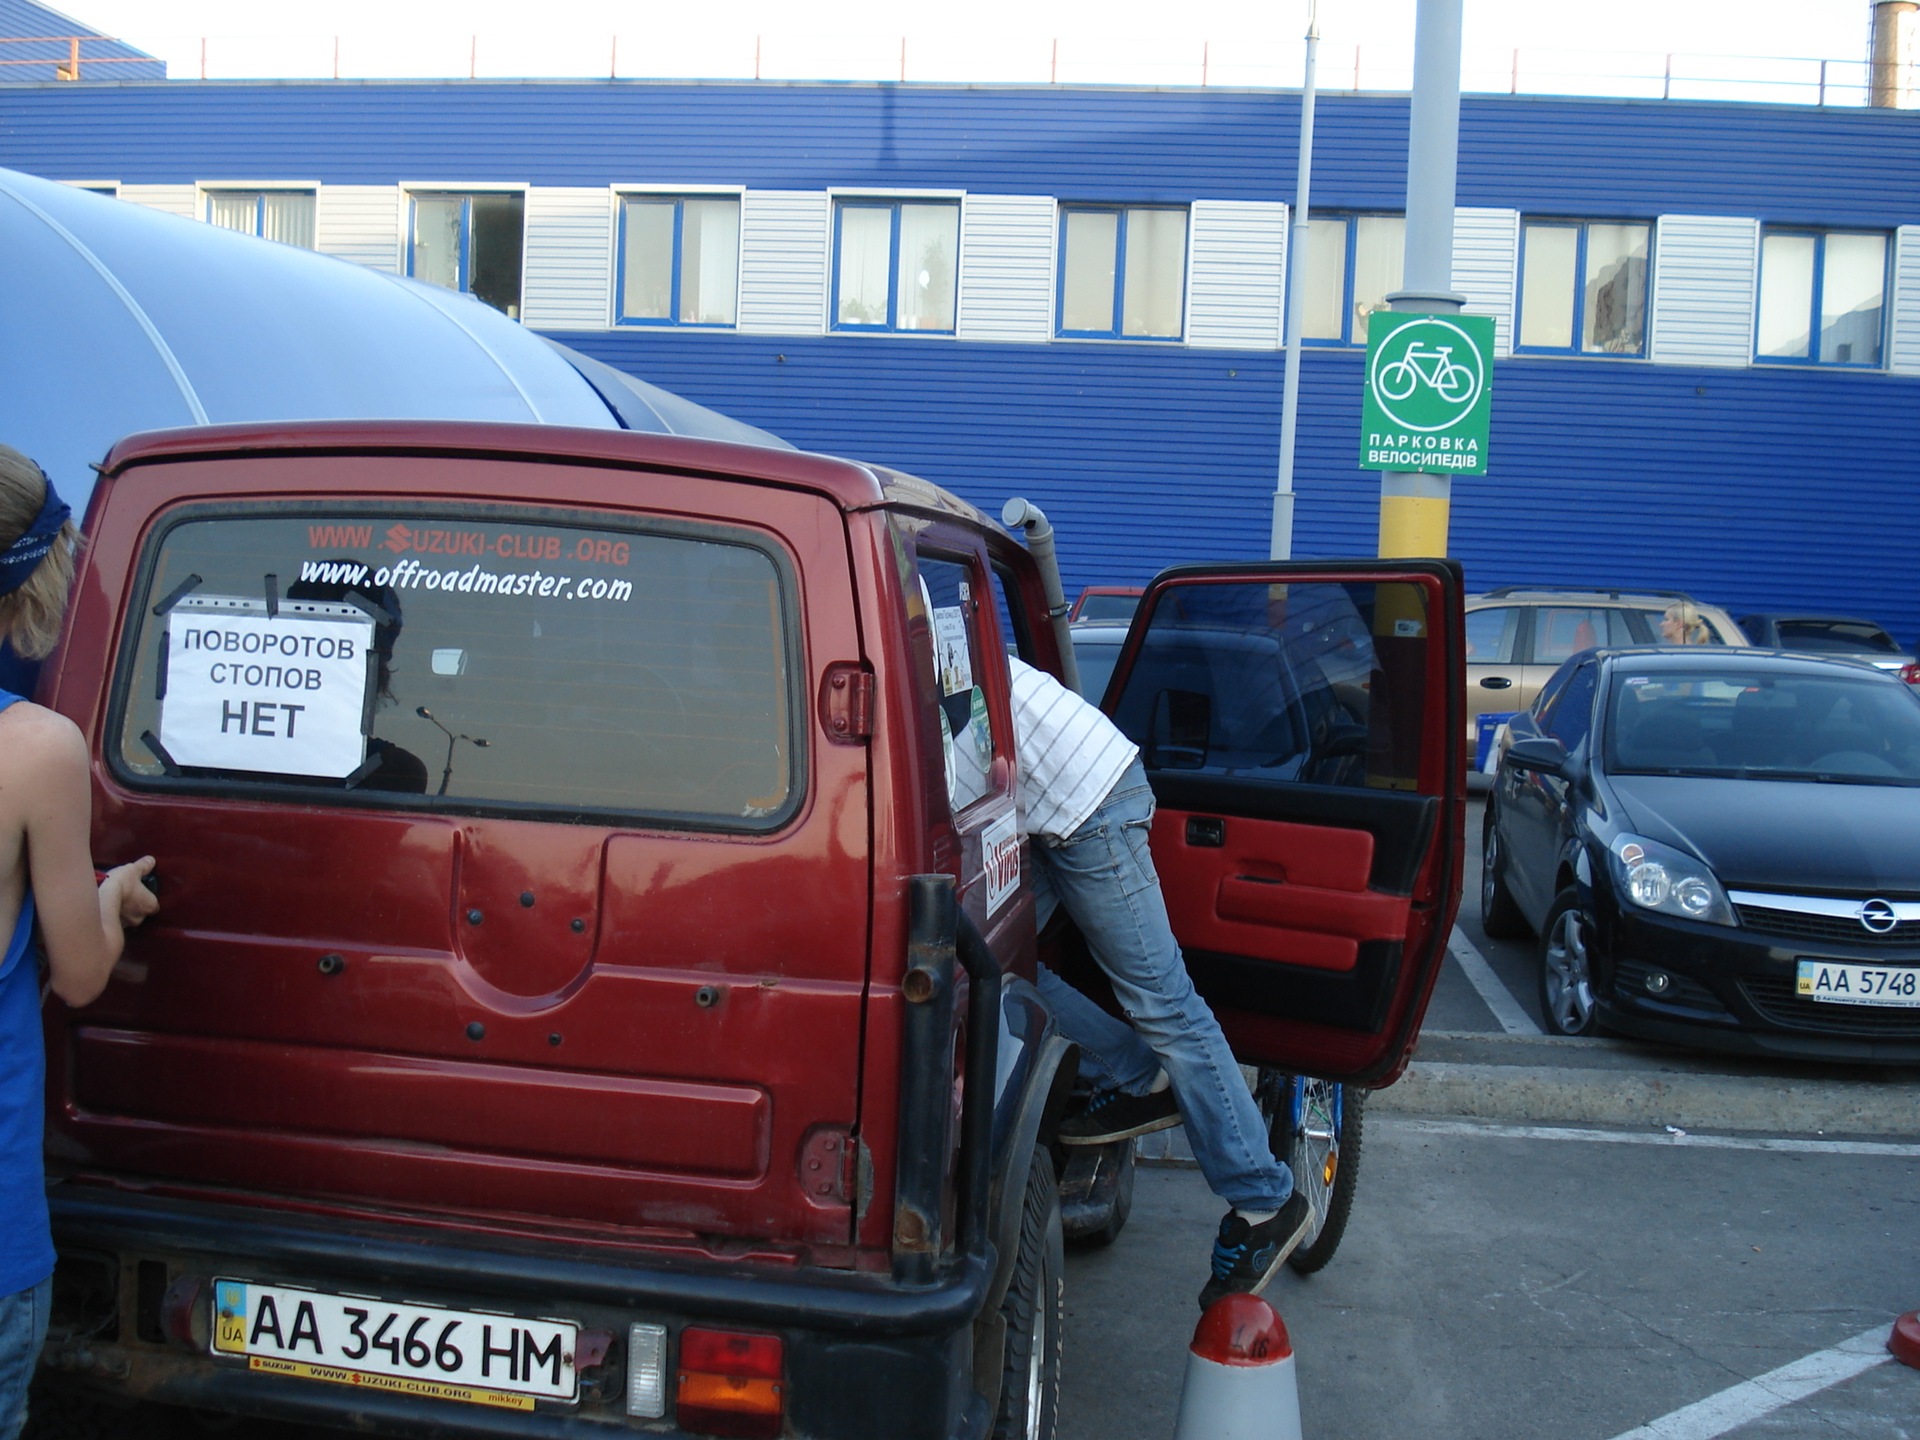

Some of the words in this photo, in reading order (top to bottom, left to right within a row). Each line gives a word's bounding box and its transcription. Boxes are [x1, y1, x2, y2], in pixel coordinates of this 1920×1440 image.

[1369, 433, 1478, 452] ПАРКОВКА
[1368, 450, 1477, 469] ВЕЛОСИПЕДІВ
[300, 559, 633, 601] www.offroadmaster.com
[184, 628, 355, 660] ПОВОРОТОВ
[210, 662, 322, 690] СТОПОВ
[221, 699, 305, 738] НЕТ
[1799, 982, 1811, 990] UA
[1815, 967, 1850, 993] AA
[1859, 971, 1916, 996] 5748
[222, 1326, 243, 1342] UA
[250, 1295, 323, 1354] AA
[341, 1306, 463, 1372] 3466
[481, 1324, 562, 1385] HM
[262, 1361, 296, 1372] SUZUKI
[488, 1394, 523, 1406] mikkey
